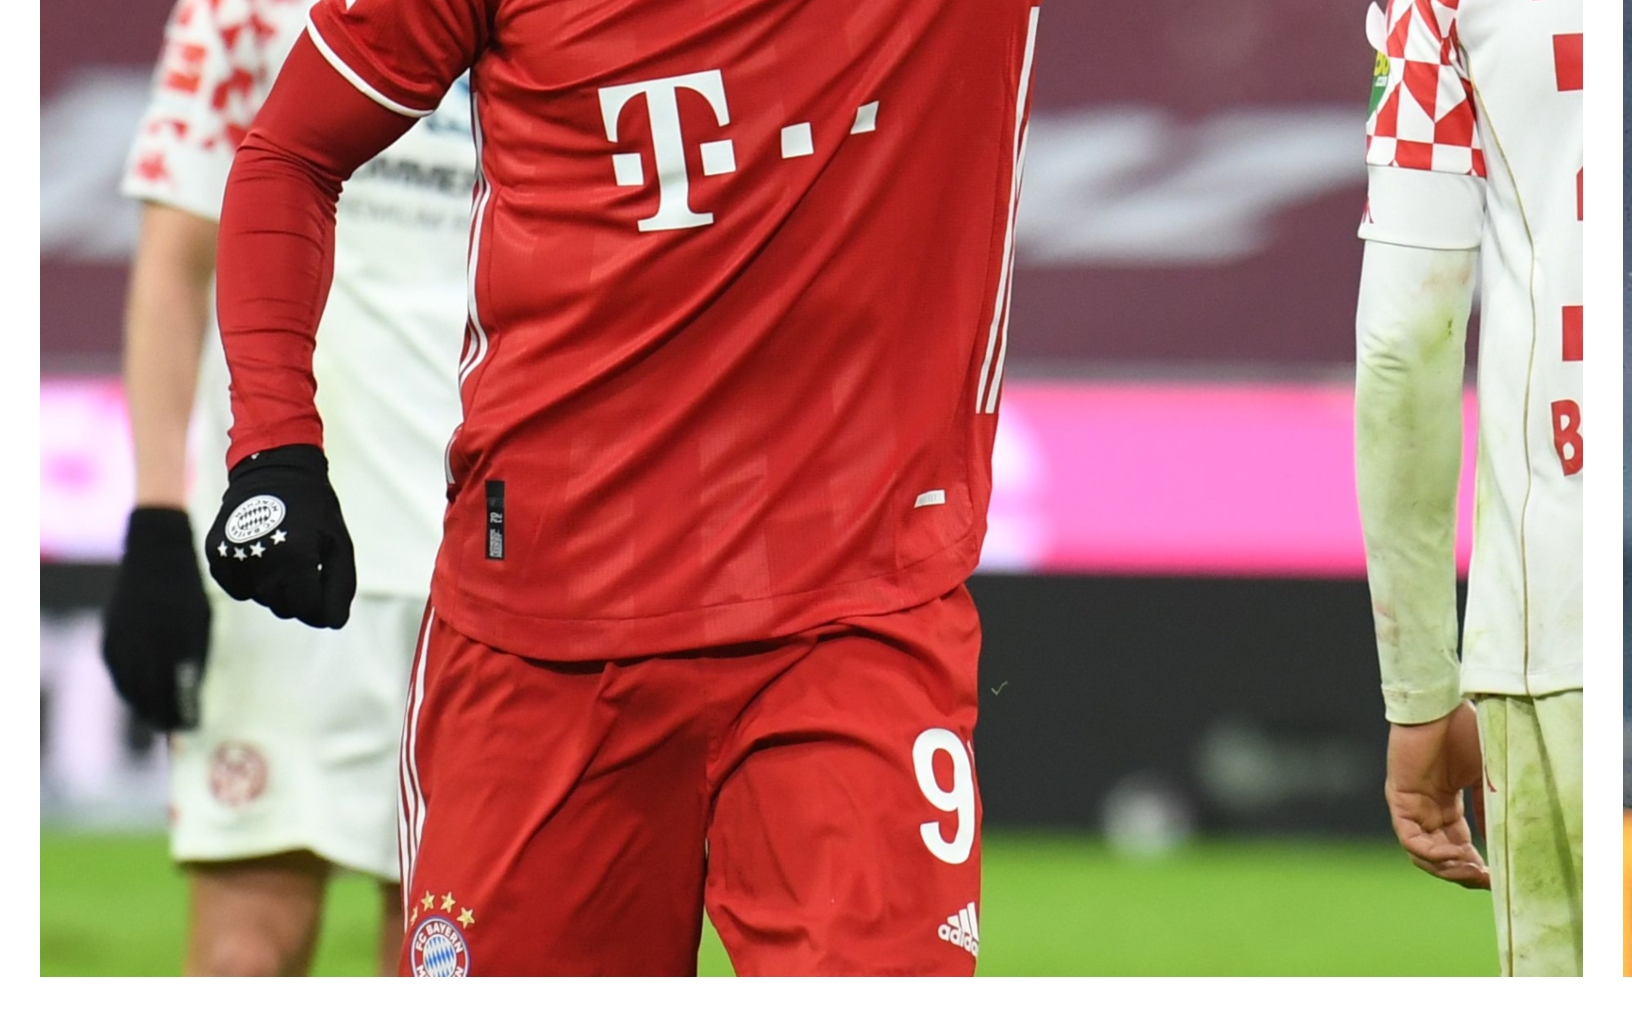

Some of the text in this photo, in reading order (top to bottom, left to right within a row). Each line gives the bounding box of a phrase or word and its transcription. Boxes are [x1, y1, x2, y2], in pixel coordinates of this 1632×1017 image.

[912, 727, 975, 865] 9
[425, 922, 464, 954] BAYERN
[937, 923, 980, 958] adida
